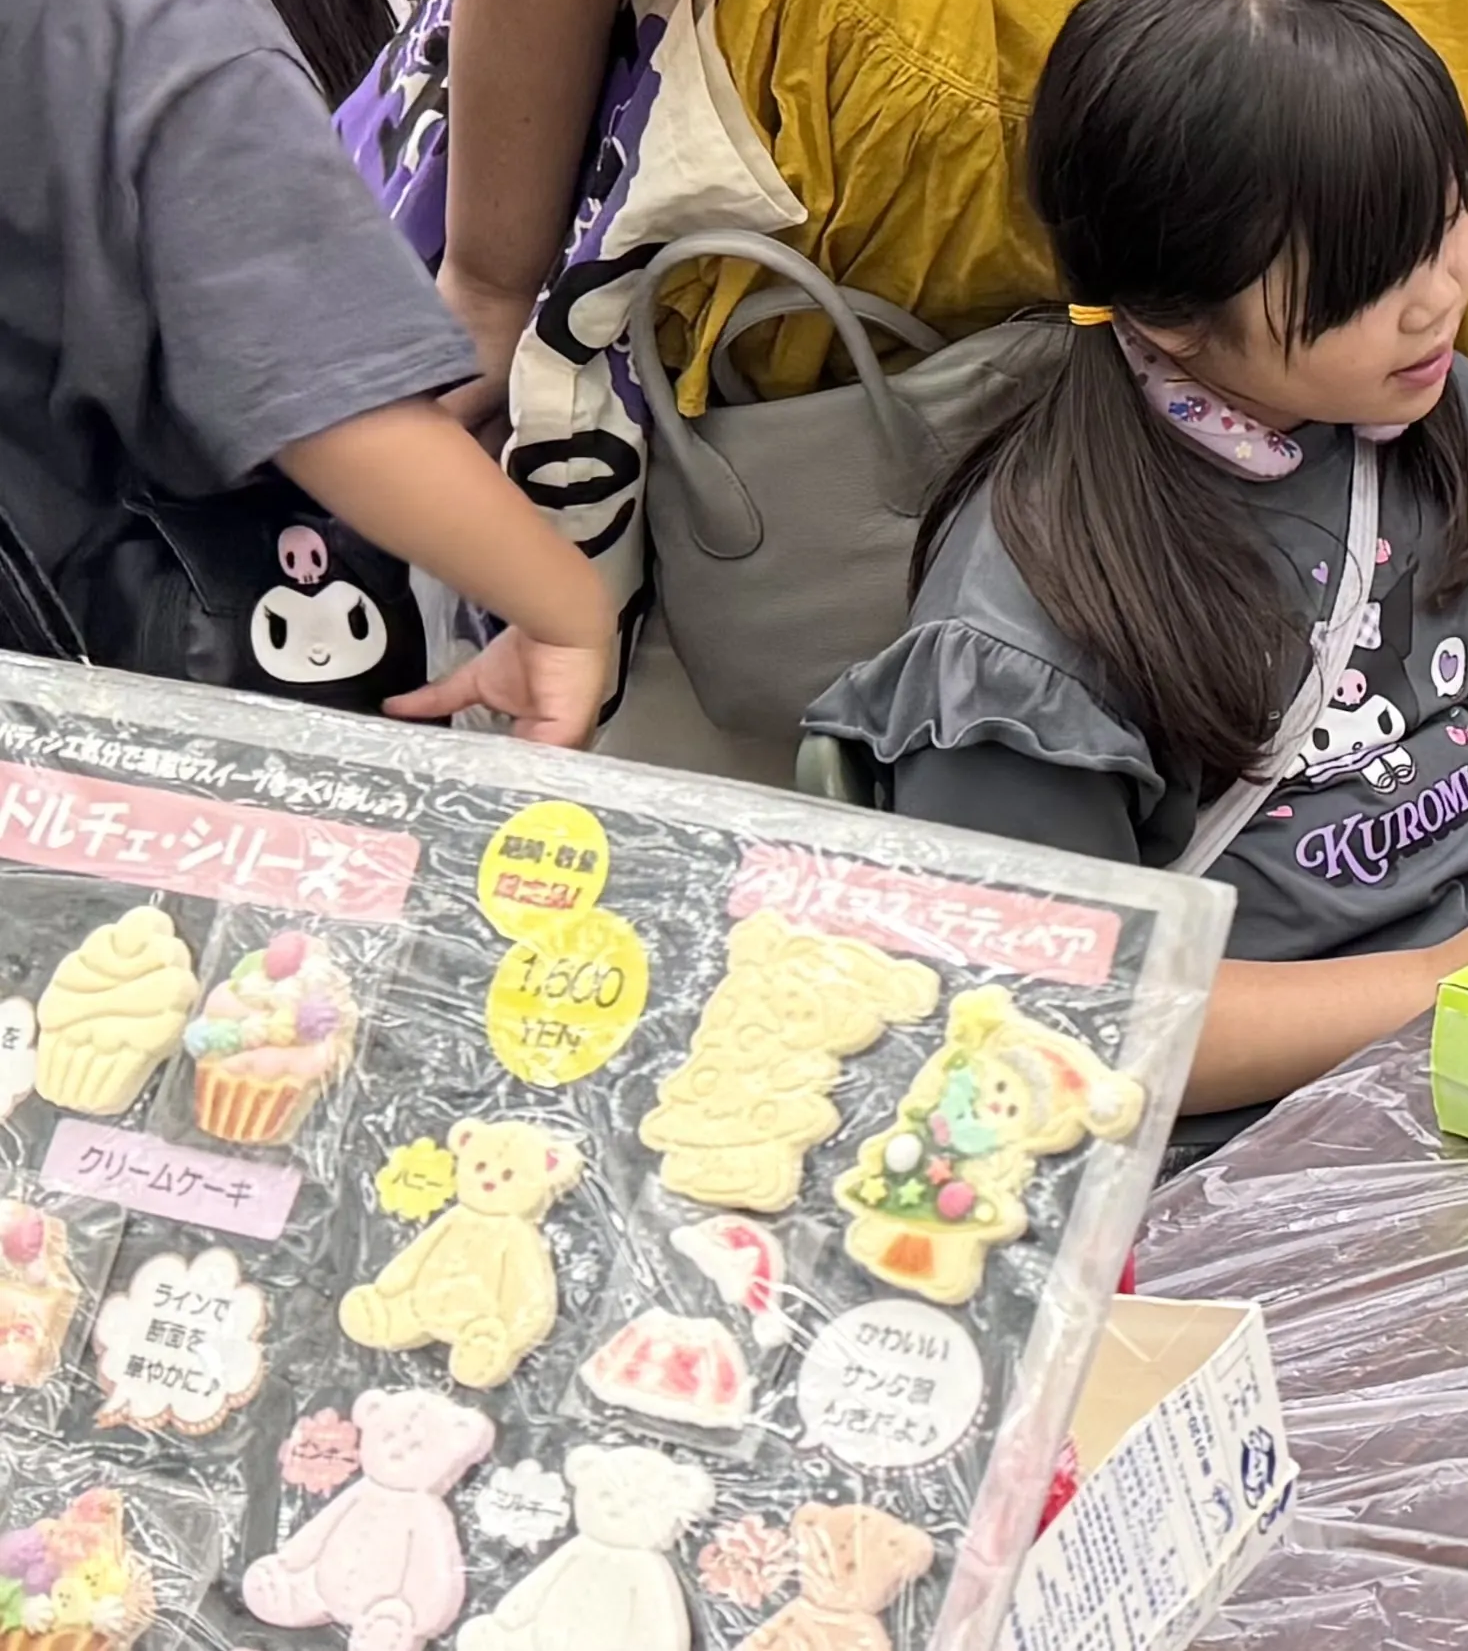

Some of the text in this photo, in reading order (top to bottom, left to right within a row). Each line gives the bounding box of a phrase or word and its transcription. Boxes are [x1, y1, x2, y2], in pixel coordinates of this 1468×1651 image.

[78, 1147, 254, 1208] クリームケーキ
[153, 1282, 233, 1323] ラインで
